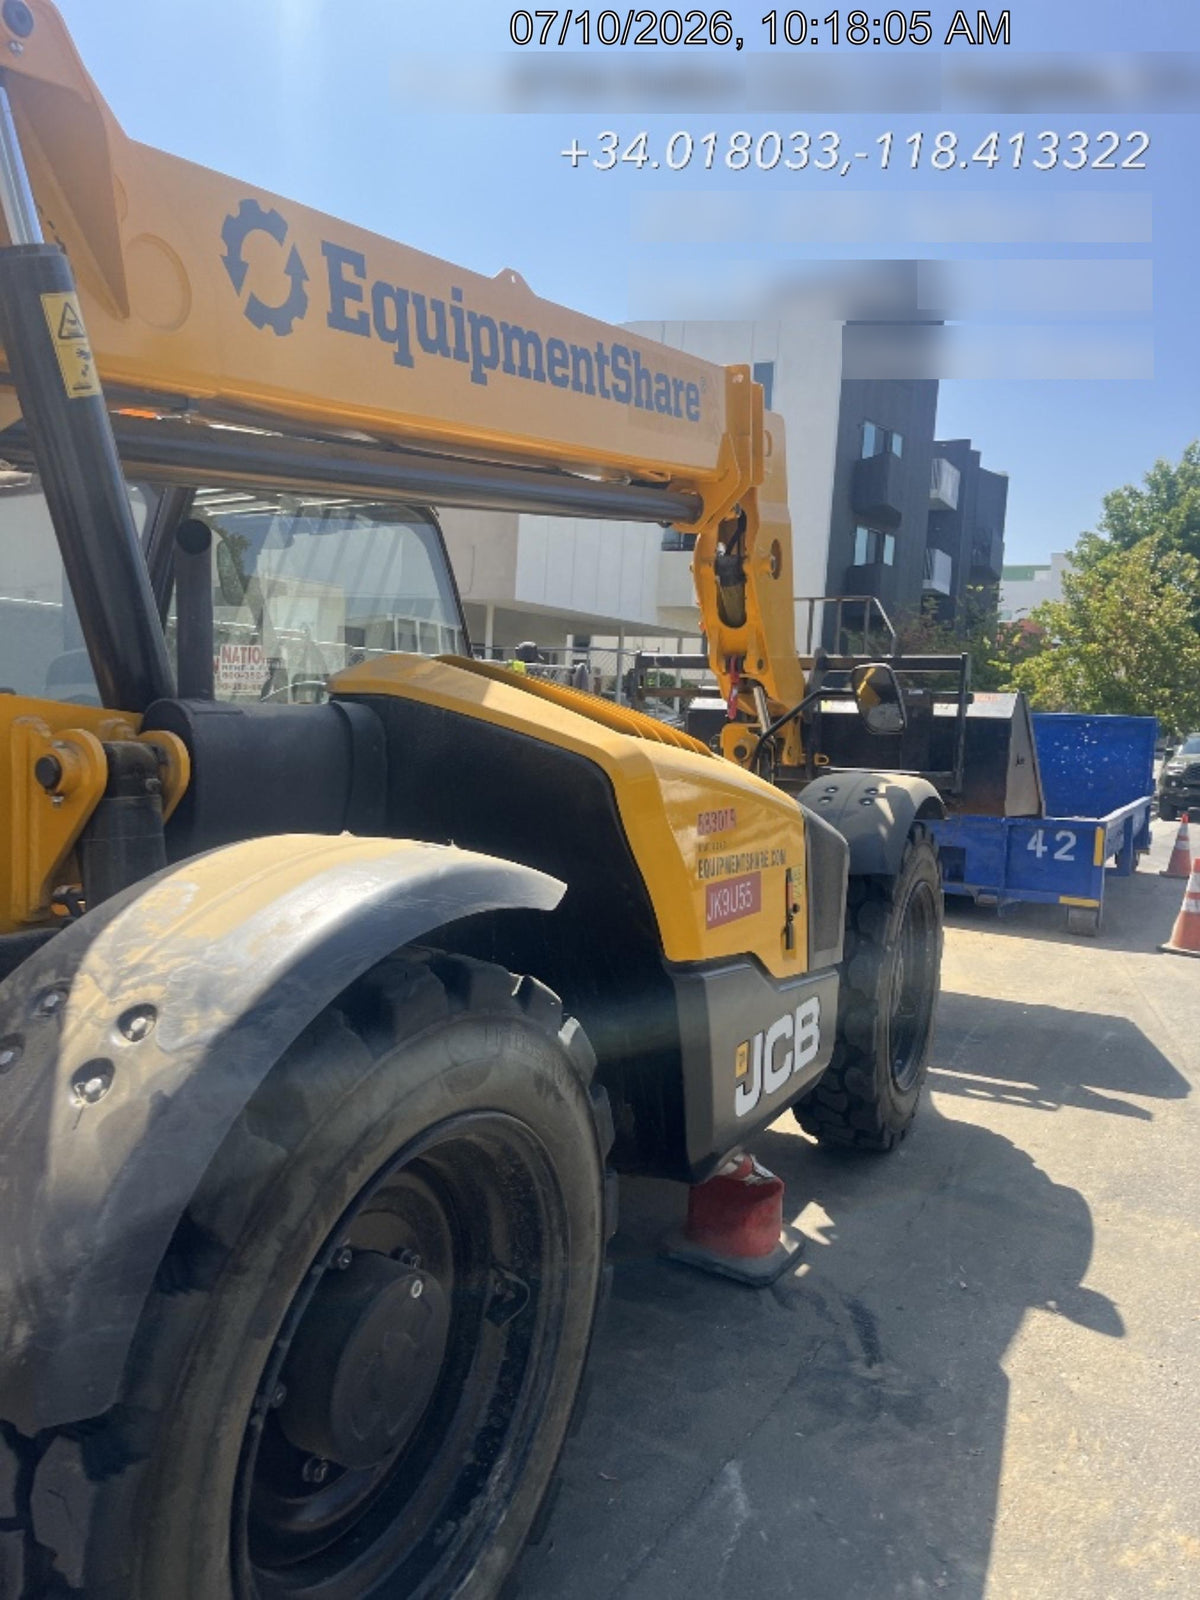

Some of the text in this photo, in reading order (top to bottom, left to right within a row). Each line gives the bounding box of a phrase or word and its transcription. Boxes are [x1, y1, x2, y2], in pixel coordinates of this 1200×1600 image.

[320, 239, 700, 422] EquipmentShare
[1027, 829, 1077, 862] 42
[735, 996, 821, 1117] JCB
